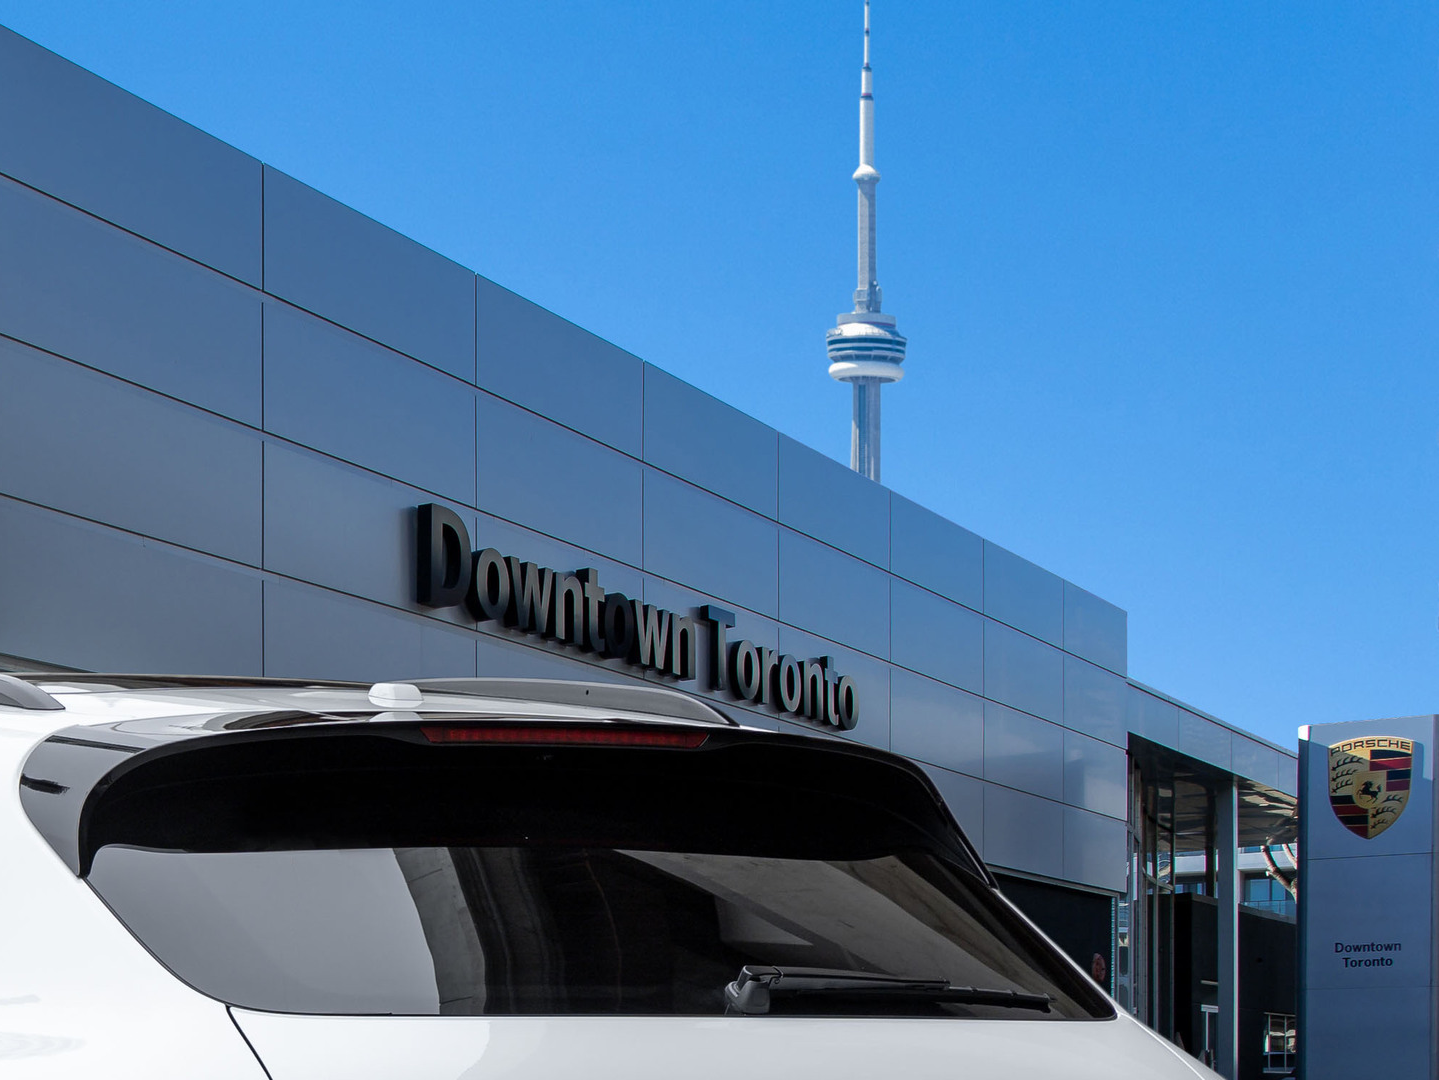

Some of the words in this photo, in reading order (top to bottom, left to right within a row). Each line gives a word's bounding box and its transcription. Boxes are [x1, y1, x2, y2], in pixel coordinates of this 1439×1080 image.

[417, 503, 696, 681] Downtown
[699, 604, 860, 731] Toronto
[1330, 739, 1411, 755] PORSCHE
[1334, 942, 1401, 953] Downtown
[1342, 957, 1393, 968] Toronto
